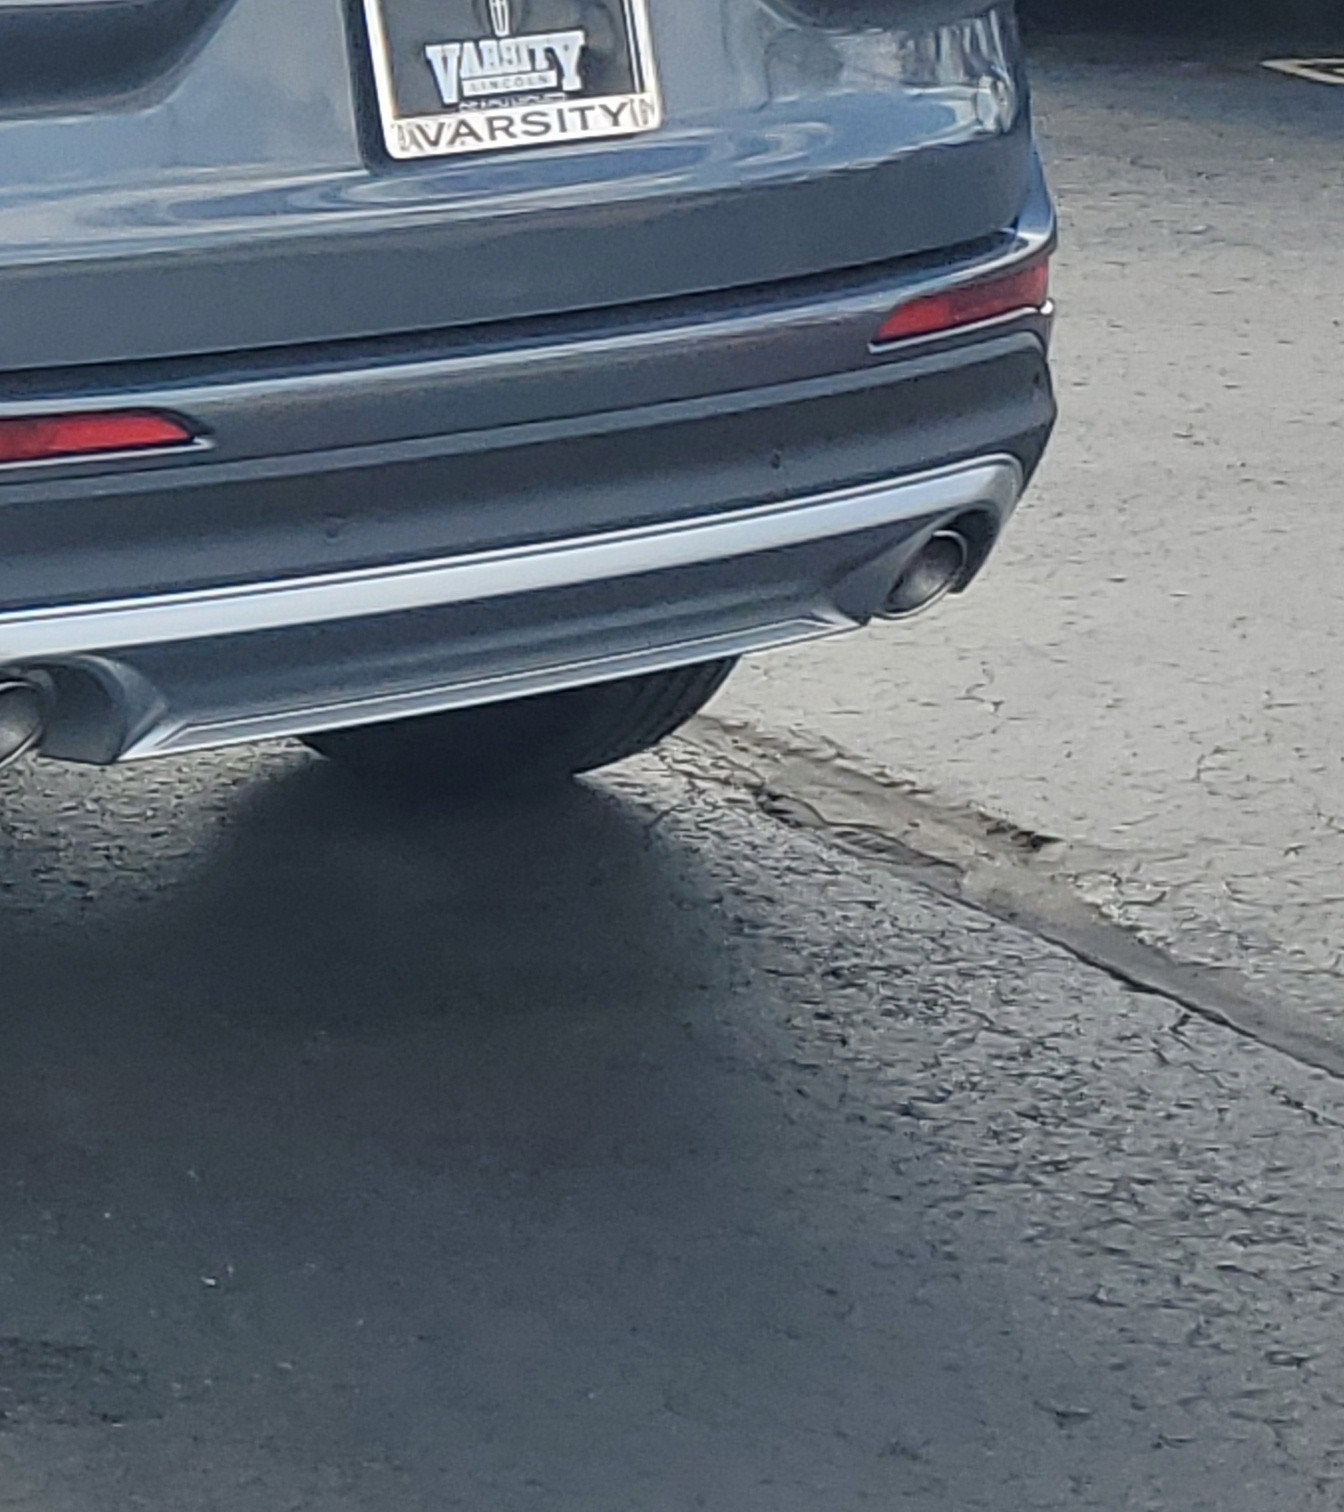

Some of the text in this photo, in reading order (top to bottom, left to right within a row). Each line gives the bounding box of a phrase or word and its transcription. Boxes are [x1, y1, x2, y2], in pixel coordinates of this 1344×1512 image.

[424, 29, 586, 105] VARSITY
[469, 73, 550, 92] LINCOLN
[415, 101, 629, 148] VARSITY
